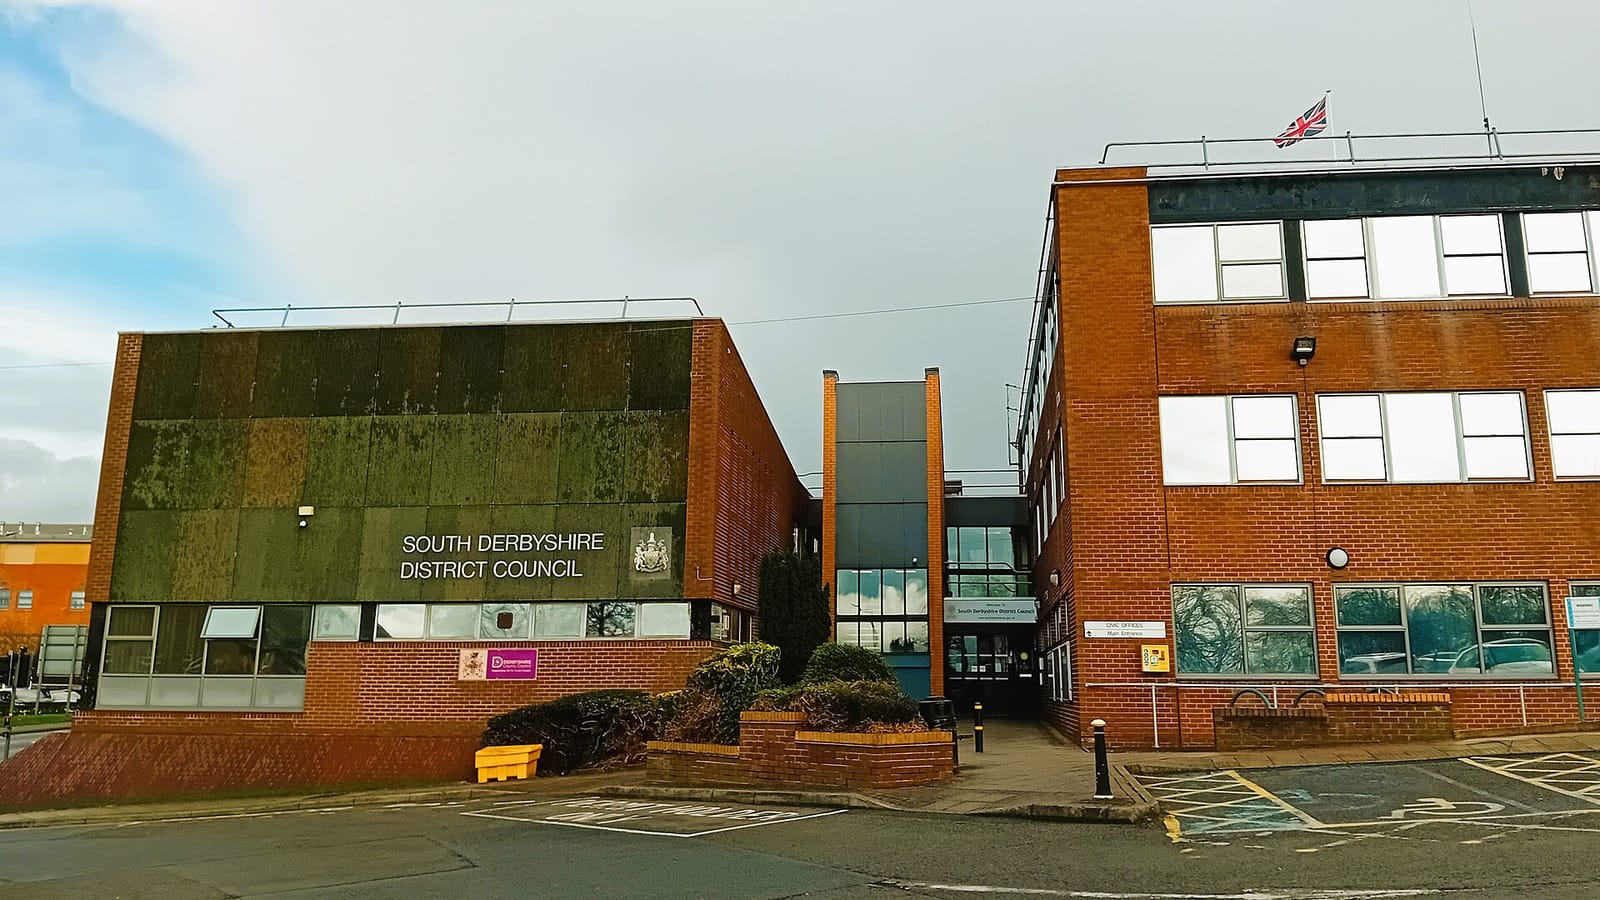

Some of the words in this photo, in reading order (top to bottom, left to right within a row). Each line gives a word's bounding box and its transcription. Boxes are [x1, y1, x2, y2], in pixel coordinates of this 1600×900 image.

[402, 535, 471, 553] SOUTH
[478, 533, 604, 552] DERBYSHIRE
[400, 561, 487, 579] DISTRICT
[493, 560, 583, 578] COUNCIL
